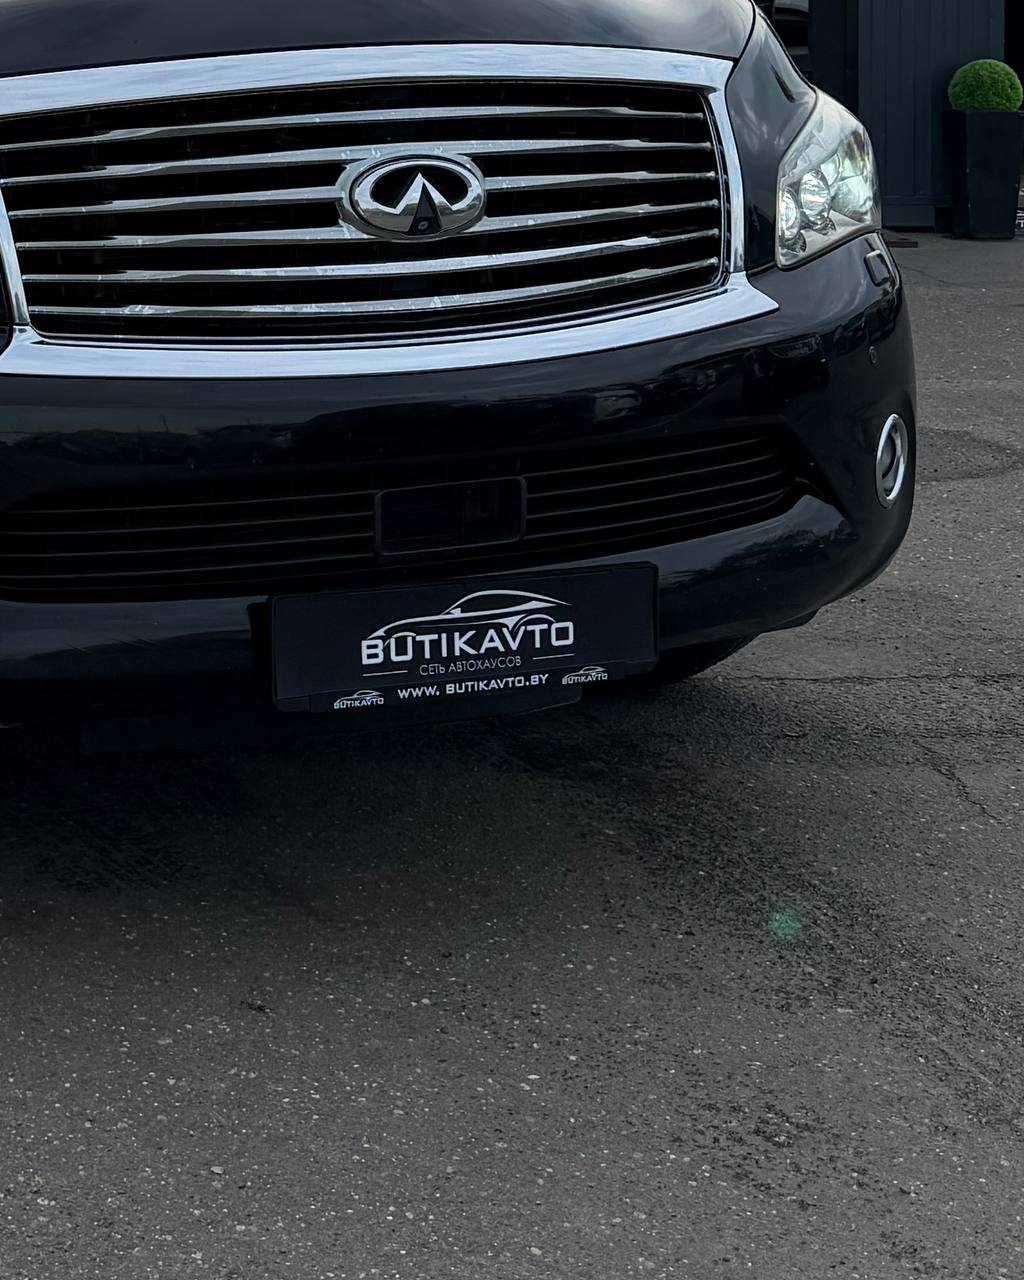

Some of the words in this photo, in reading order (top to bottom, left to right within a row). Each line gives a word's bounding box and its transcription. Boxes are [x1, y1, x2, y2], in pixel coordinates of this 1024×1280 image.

[361, 621, 575, 665] BUTIKAVTO
[448, 656, 522, 673] АВТОХАУСОВ
[445, 673, 550, 695] BUTIKAVTO.BY
[333, 697, 385, 709] BUTIKAVTO
